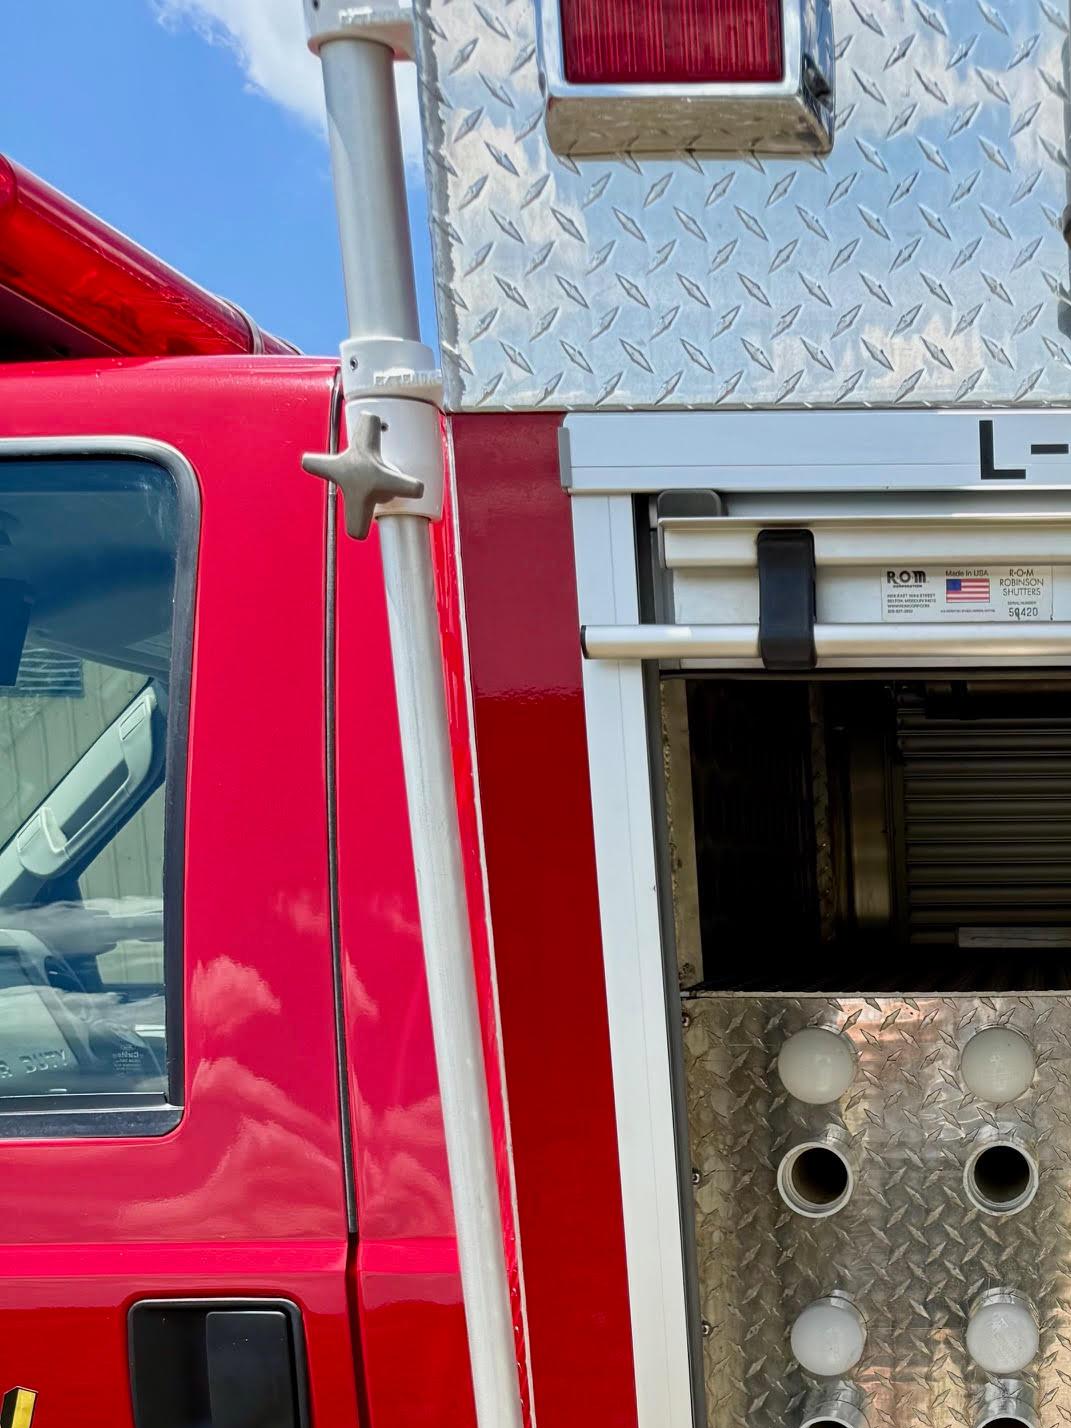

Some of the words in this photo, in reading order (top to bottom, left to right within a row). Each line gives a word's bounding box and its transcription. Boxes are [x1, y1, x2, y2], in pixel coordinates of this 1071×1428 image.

[945, 569, 964, 577] Made
[973, 569, 989, 577] USA
[999, 578, 1044, 587] ROBINSON
[1002, 587, 1041, 596] SHUTTERS
[18, 1049, 67, 1073] DUTY
